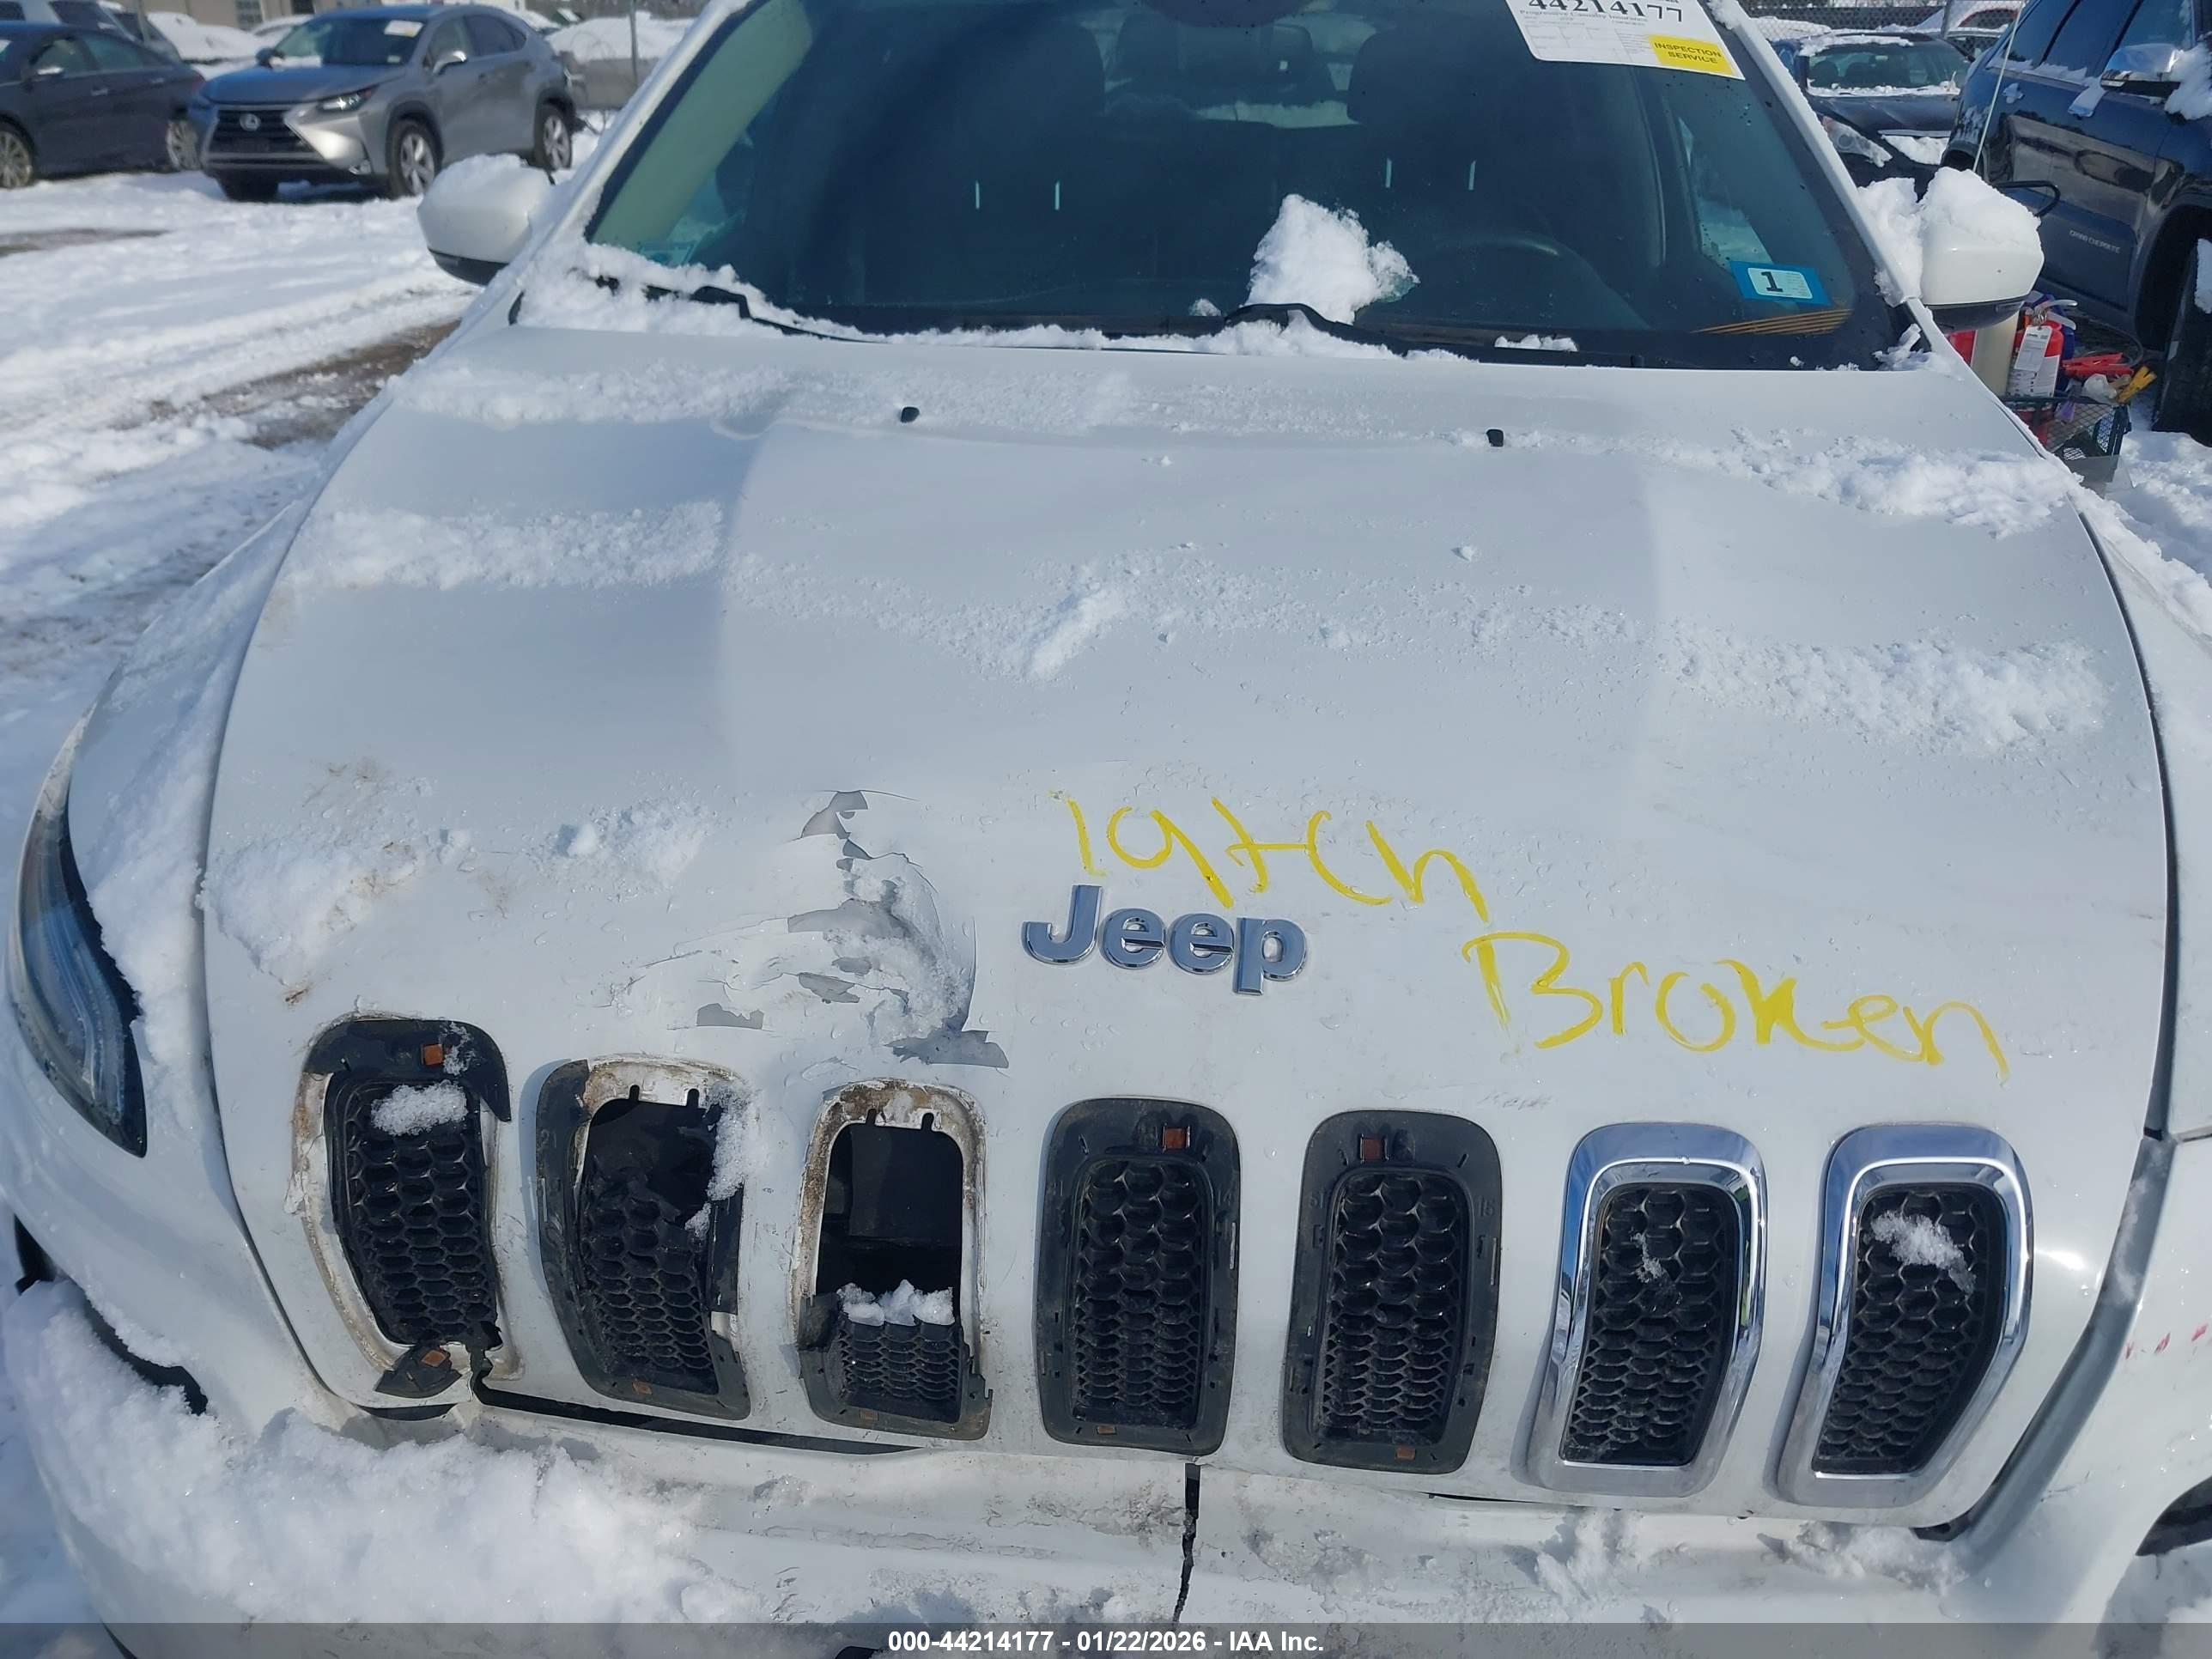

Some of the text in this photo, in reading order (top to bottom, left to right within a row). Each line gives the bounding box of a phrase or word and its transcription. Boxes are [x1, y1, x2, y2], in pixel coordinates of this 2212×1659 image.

[1528, 0, 1682, 22] 44214177
[1654, 42, 1722, 58] INSPECTION
[1668, 52, 1718, 64] SERVICE
[1761, 271, 1784, 293] 1
[1022, 883, 1307, 996] Jeep
[1462, 931, 2009, 1084] Broken
